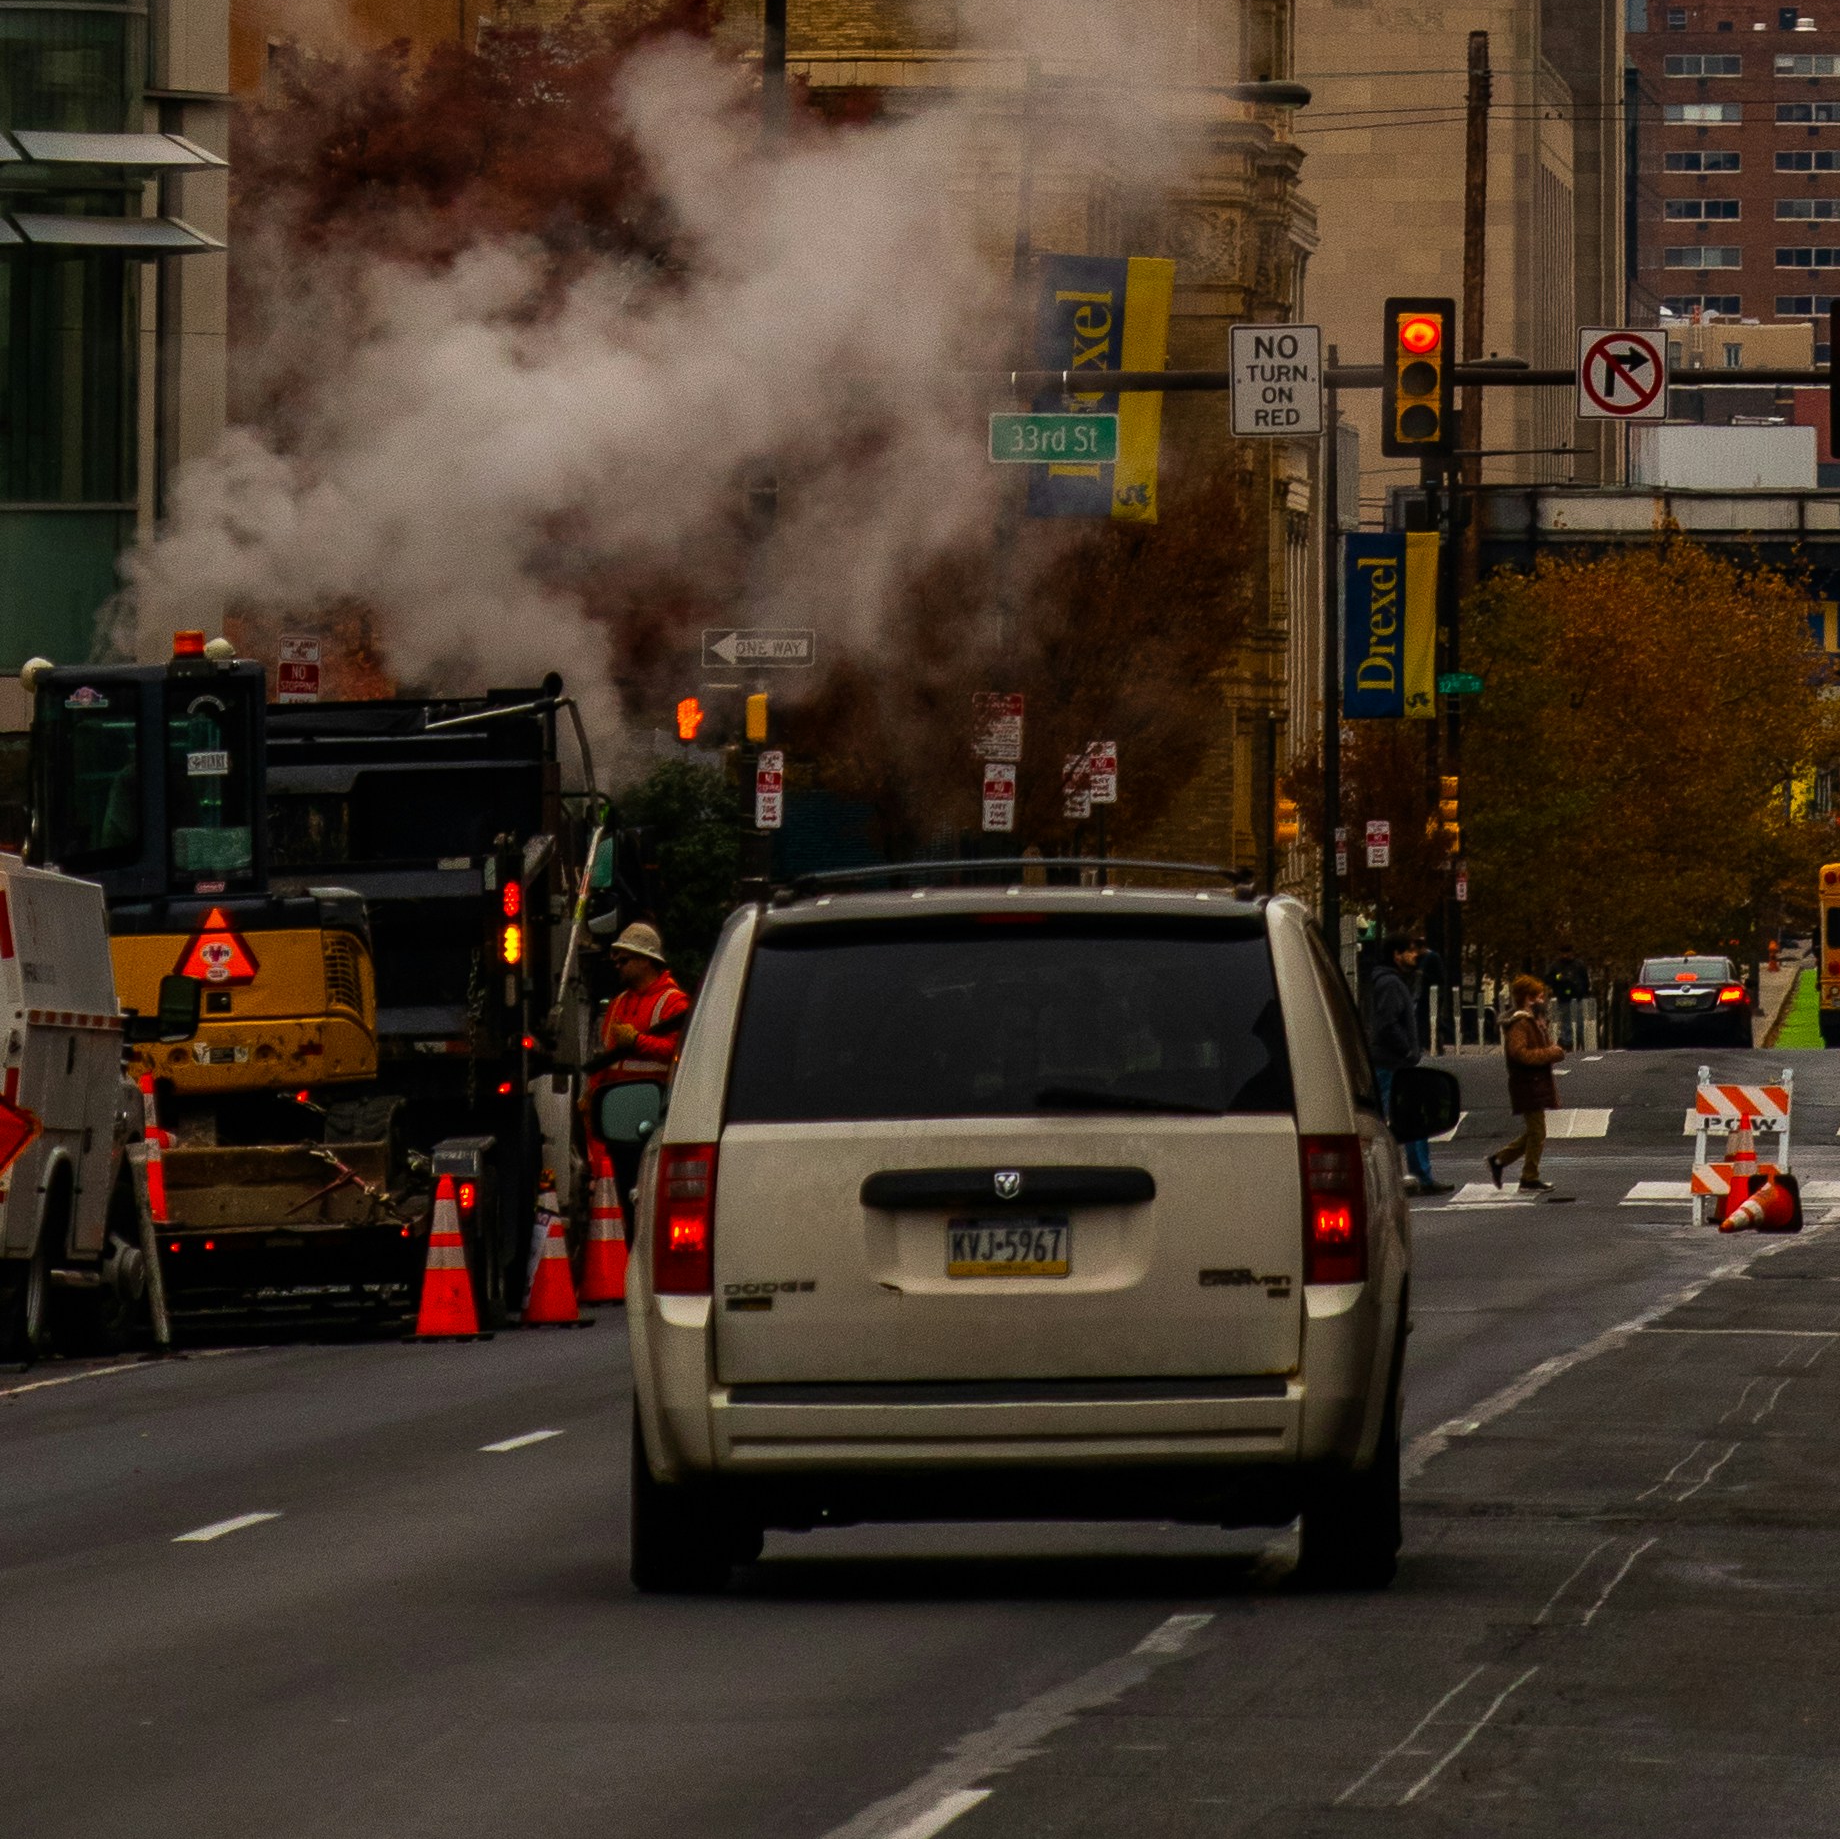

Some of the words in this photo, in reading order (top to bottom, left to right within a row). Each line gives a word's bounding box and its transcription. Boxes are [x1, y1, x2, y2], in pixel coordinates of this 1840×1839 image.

[1254, 334, 1298, 359] NO
[1246, 364, 1308, 383] TURN
[1262, 386, 1293, 404] ON
[1254, 408, 1300, 427] RED
[1010, 425, 1066, 453] 33rd
[1073, 425, 1098, 453] St
[1357, 557, 1398, 694] Drexel
[736, 641, 767, 656] ONE
[773, 641, 802, 655] WAY
[291, 665, 307, 680] NO
[280, 680, 317, 692] STOPPING
[724, 1280, 816, 1296] DODGE
